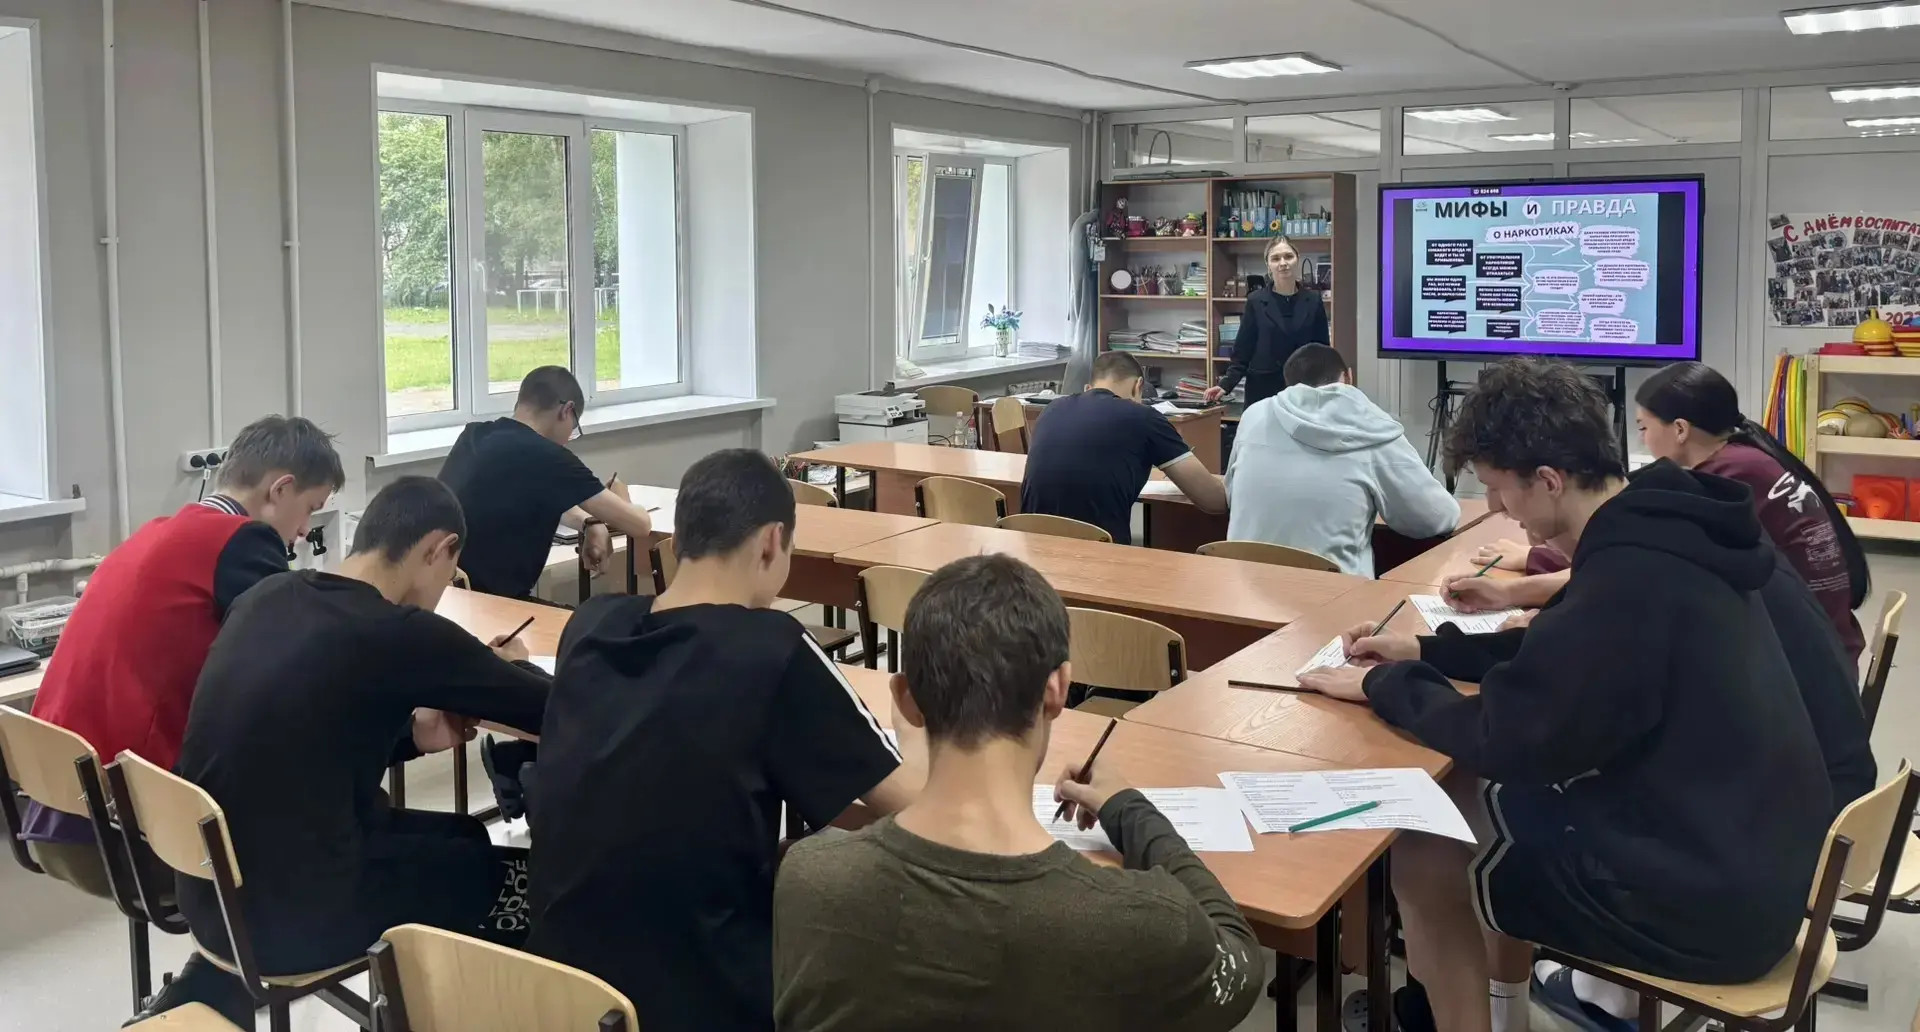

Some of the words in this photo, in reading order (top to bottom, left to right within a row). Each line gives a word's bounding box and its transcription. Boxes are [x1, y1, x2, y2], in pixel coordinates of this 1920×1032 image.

[1435, 201, 1507, 218] МИФЫ
[1527, 204, 1537, 215] И
[1552, 198, 1637, 218] ПРАВДА
[1493, 231, 1501, 239] О
[1503, 226, 1575, 239] НАРКОТИКАХ
[1783, 225, 1799, 242] С
[1803, 213, 1852, 236] ДНЁМ
